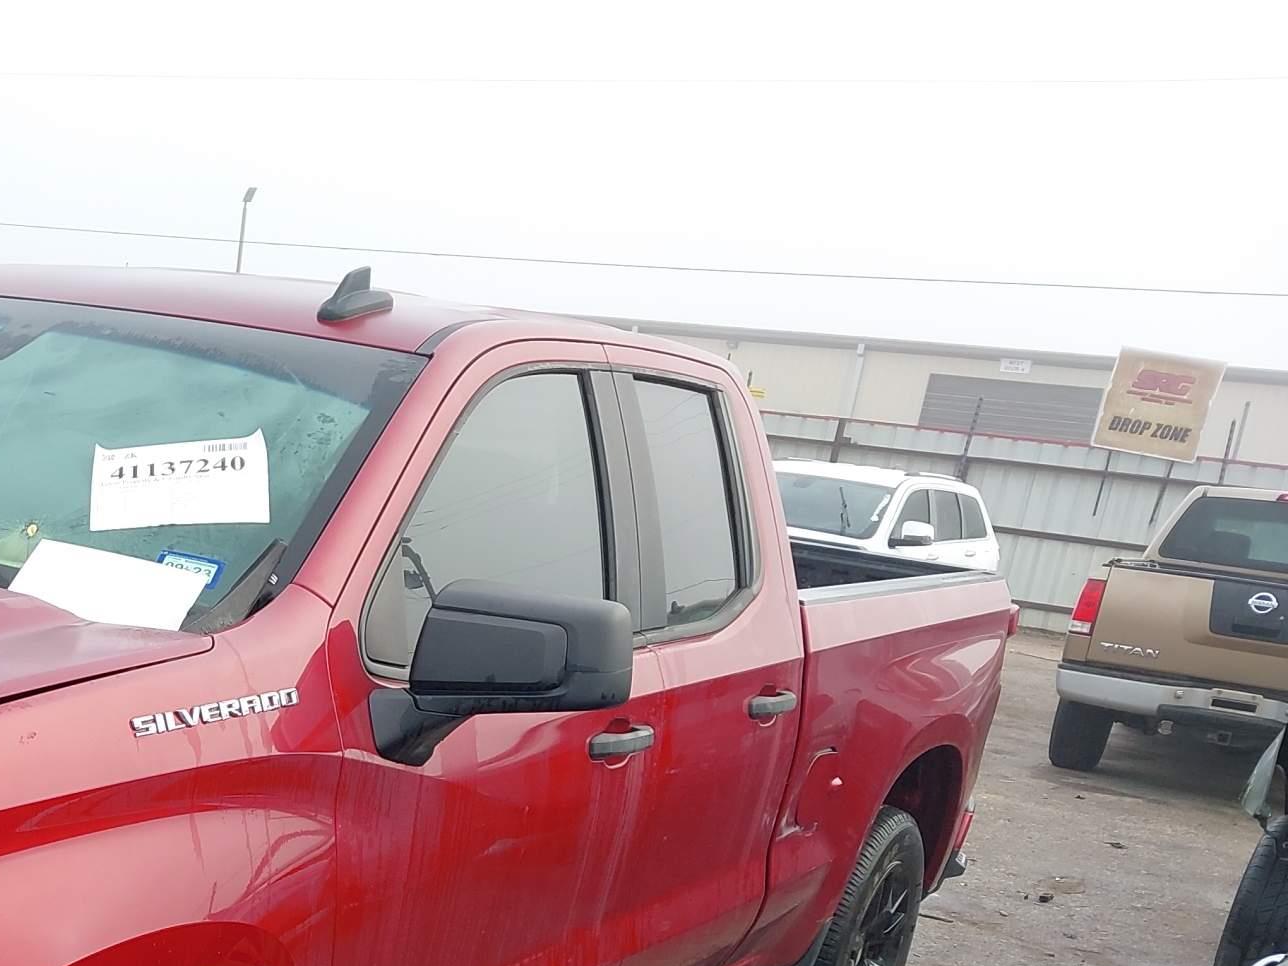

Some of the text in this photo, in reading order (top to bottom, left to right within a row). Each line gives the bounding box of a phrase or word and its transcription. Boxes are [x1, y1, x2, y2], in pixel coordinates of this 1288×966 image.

[1108, 415, 1193, 443] DROP ZONE
[110, 455, 246, 480] 41137240
[1100, 641, 1160, 659] TITAN
[129, 687, 299, 738] SILVERADO
